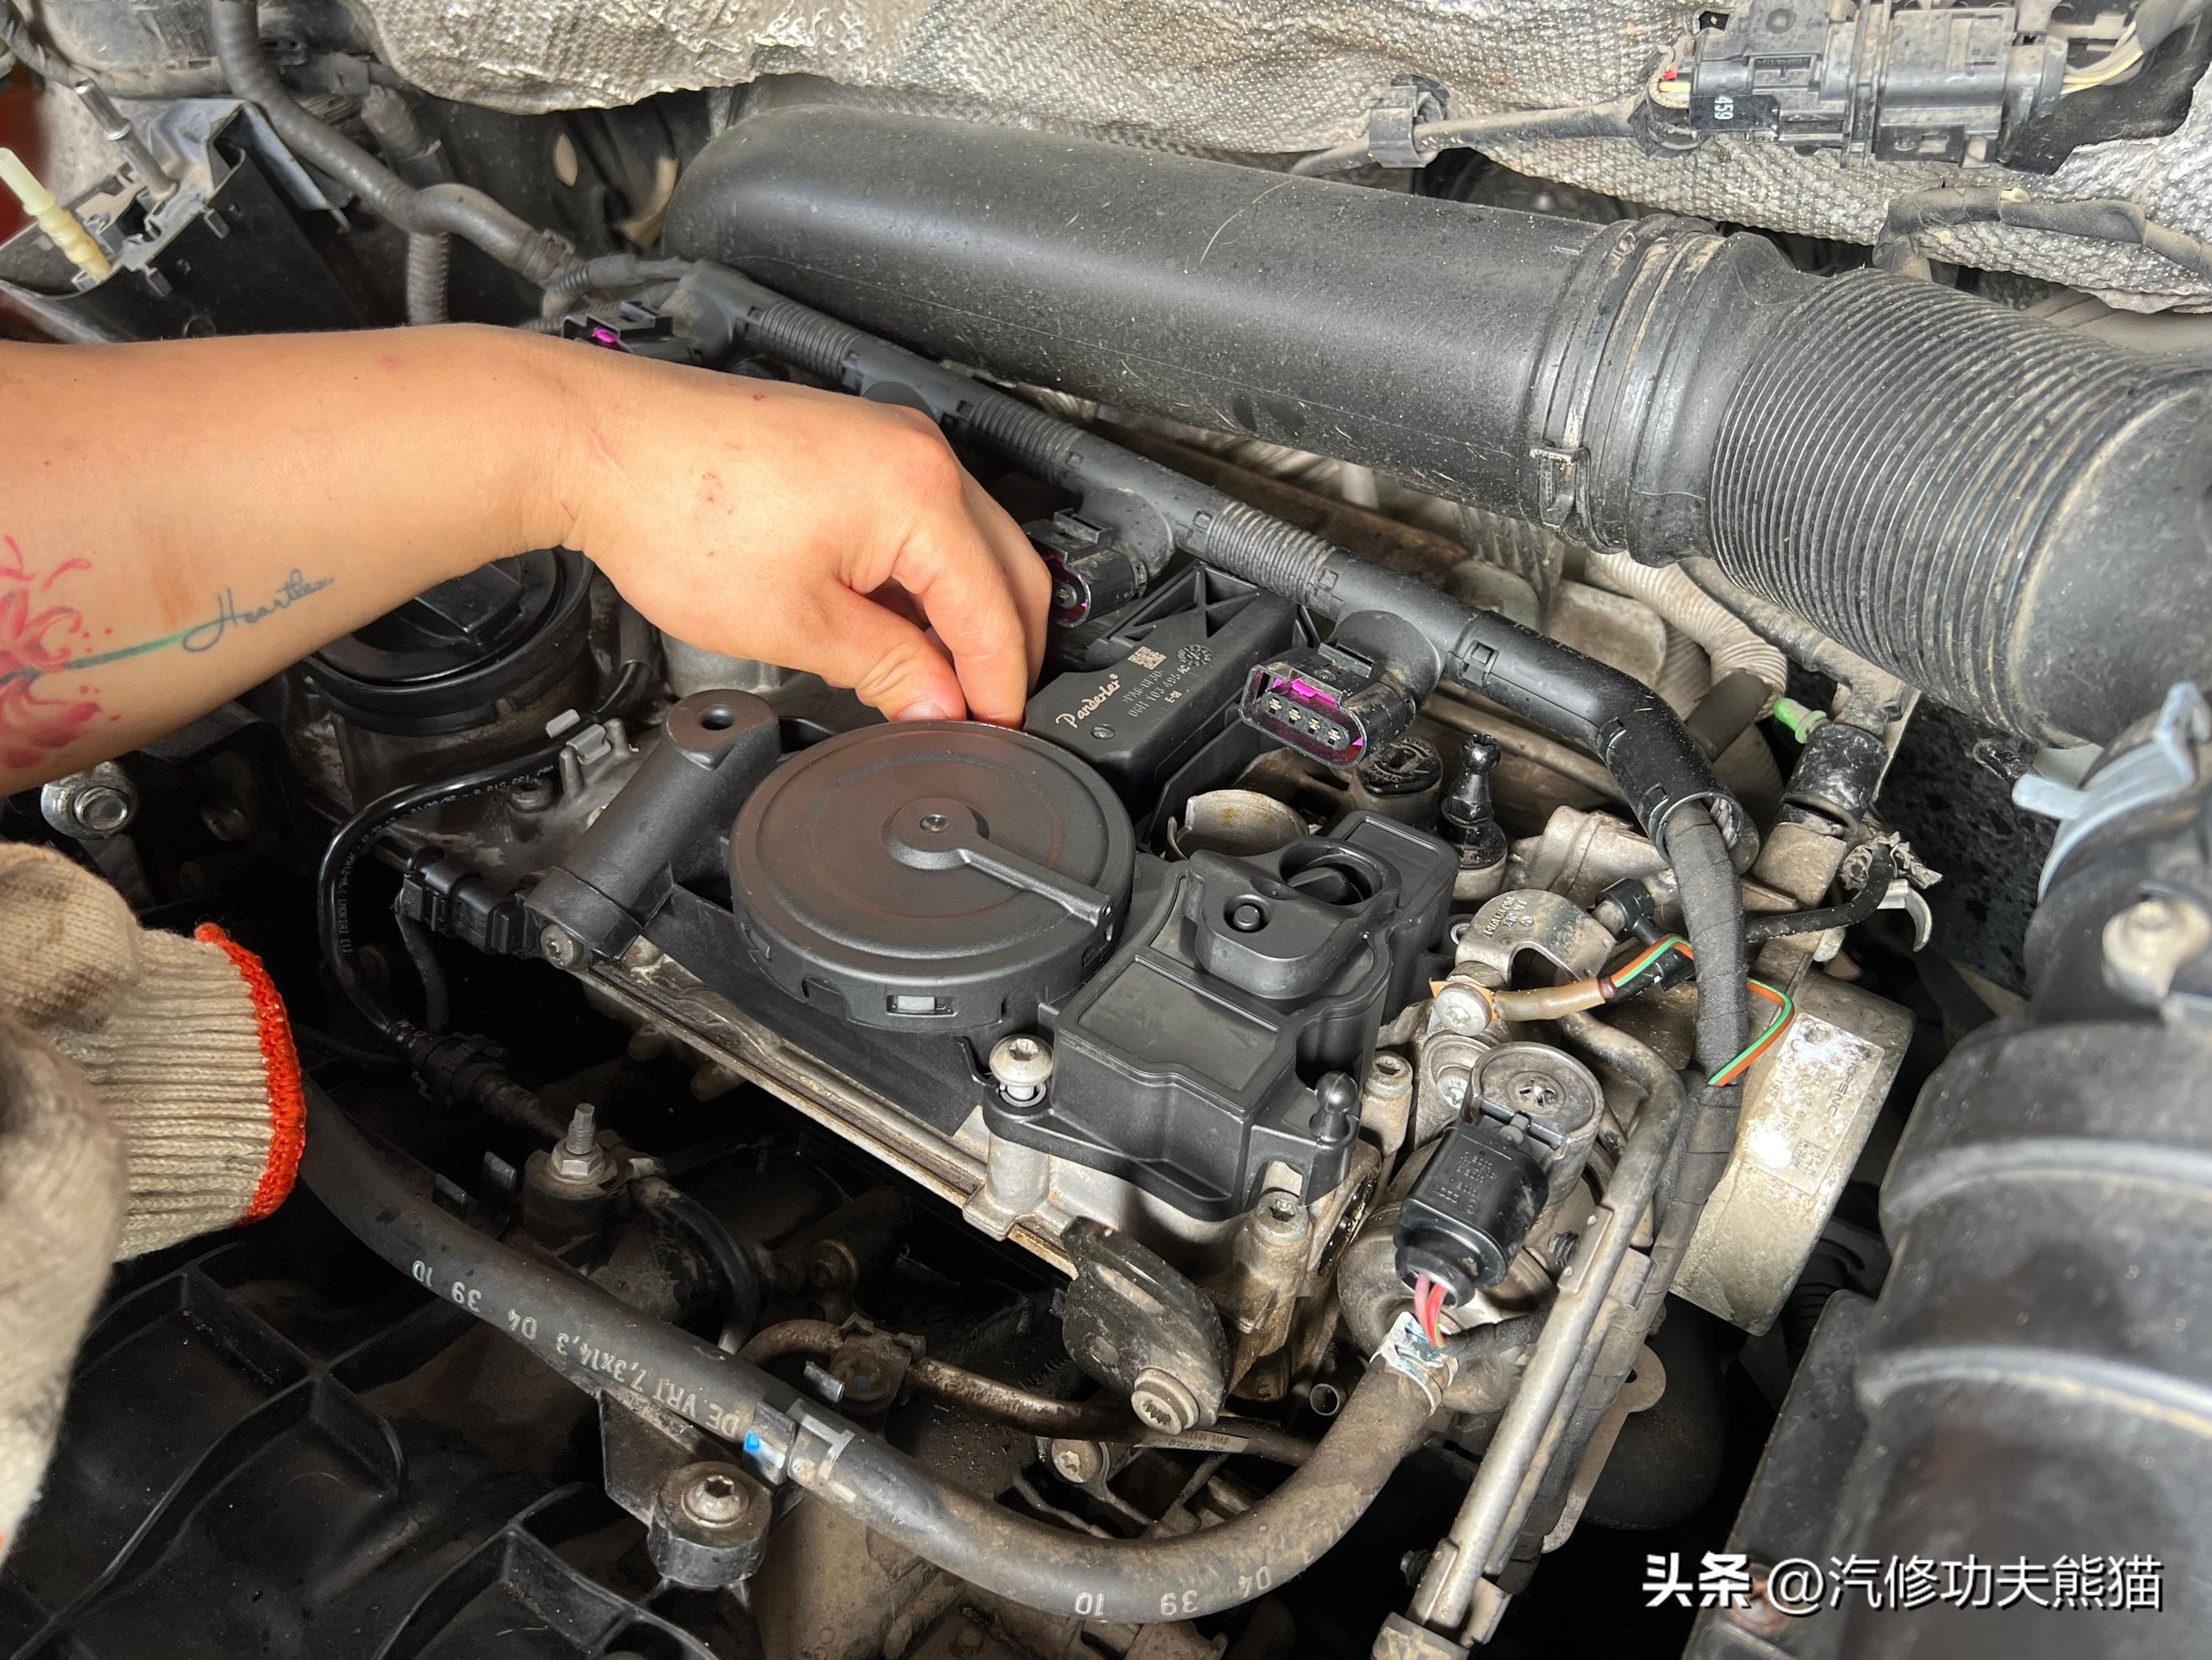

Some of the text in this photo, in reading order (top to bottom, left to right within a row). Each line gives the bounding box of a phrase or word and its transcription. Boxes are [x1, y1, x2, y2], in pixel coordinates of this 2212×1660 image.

[1713, 96, 1734, 121] 459
[413, 1260, 433, 1288] 10
[452, 1281, 482, 1313] 39
[1074, 1566, 1272, 1617] 04 39 10
